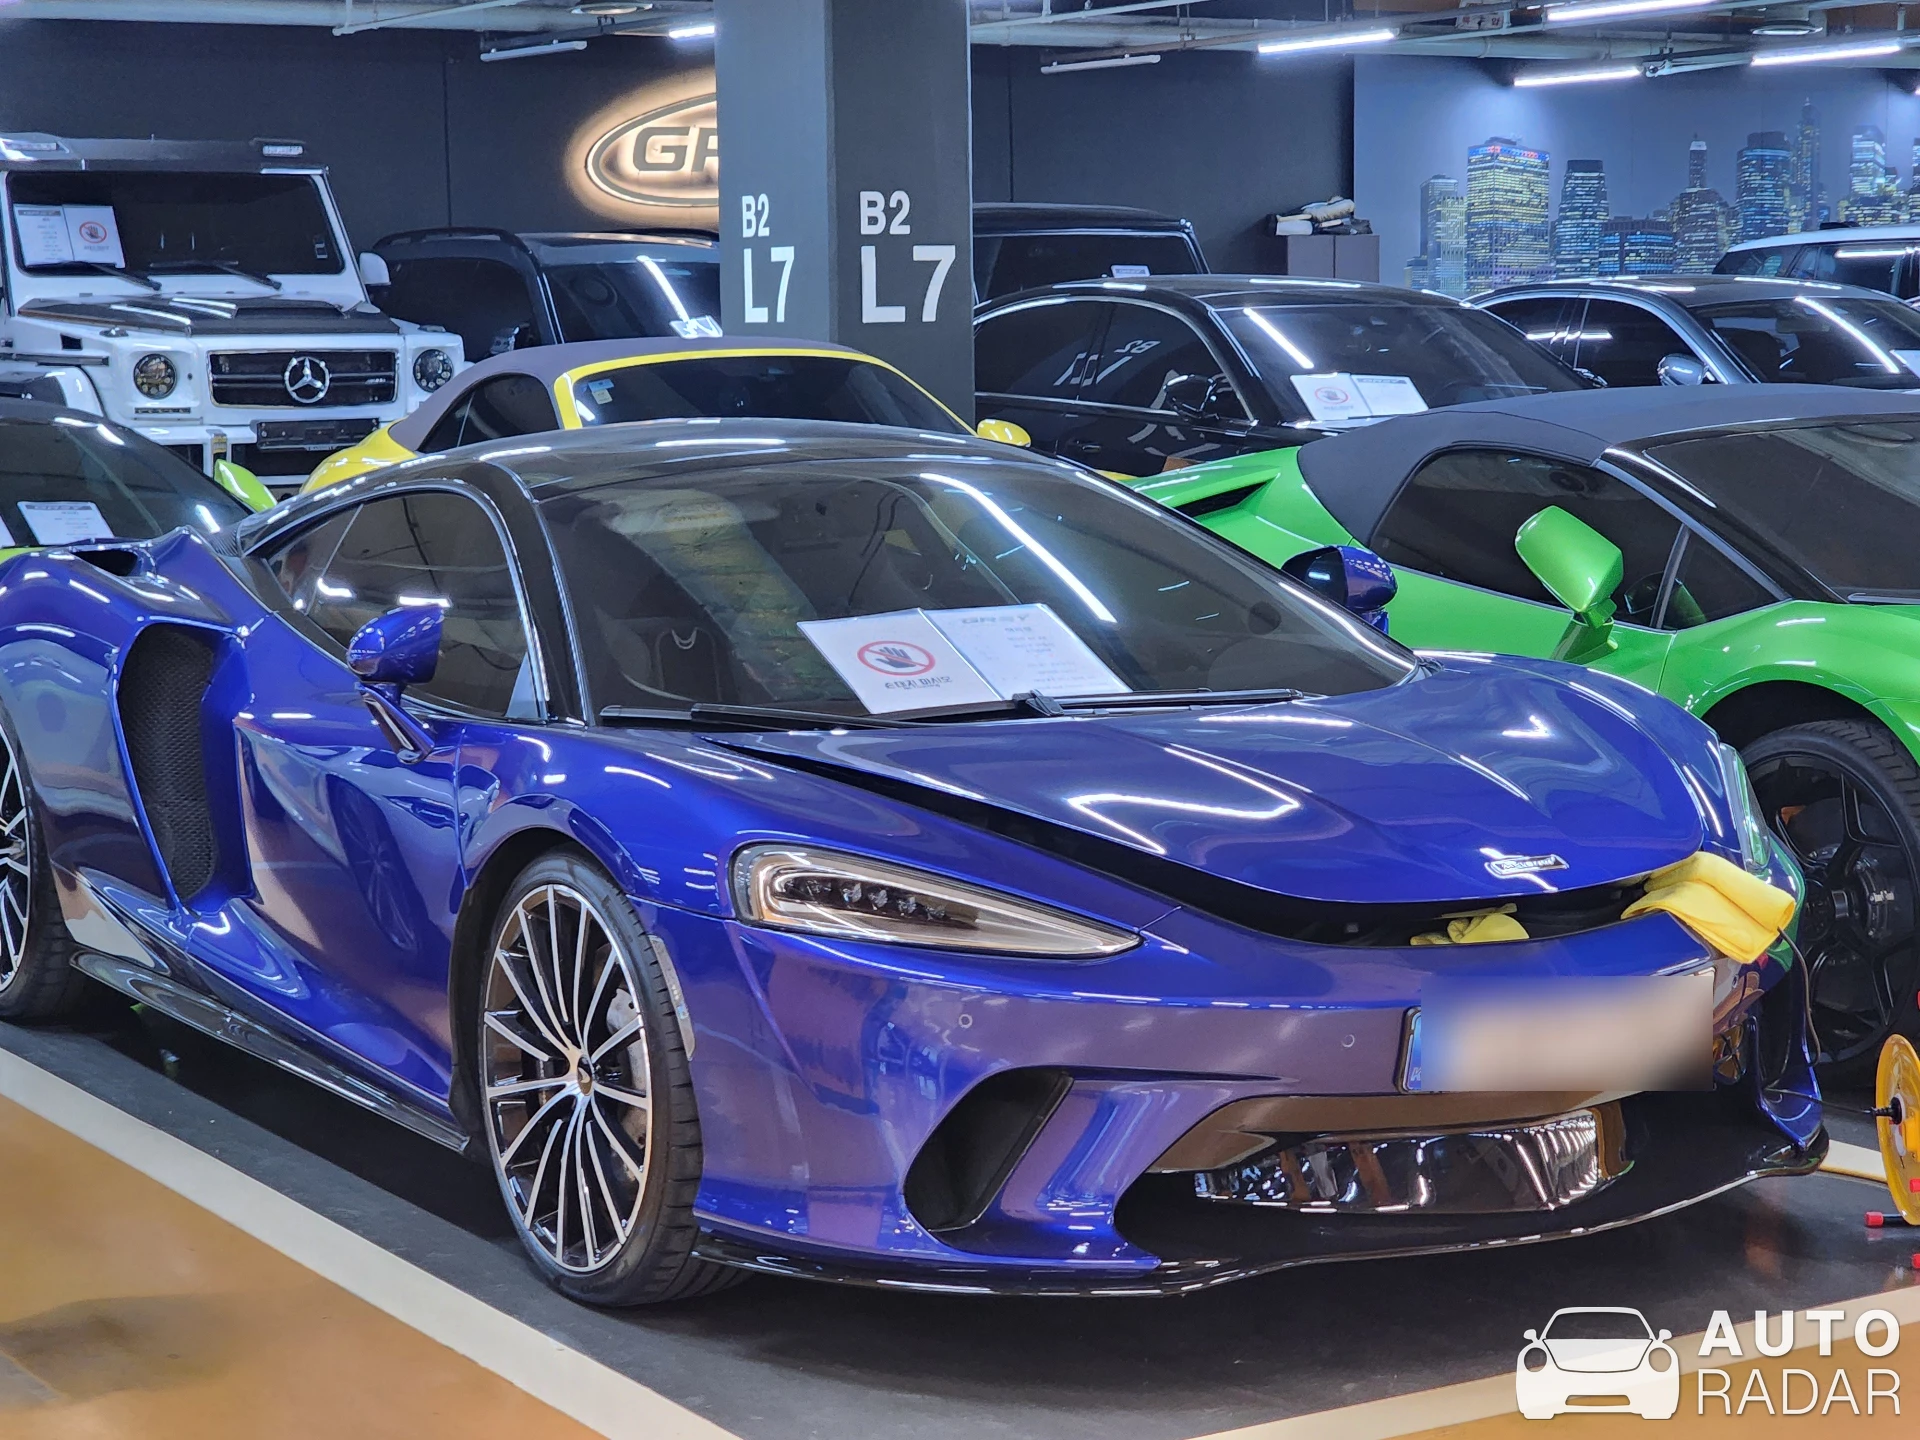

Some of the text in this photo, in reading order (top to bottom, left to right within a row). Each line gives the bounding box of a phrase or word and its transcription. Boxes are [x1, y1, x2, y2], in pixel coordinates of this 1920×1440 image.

[742, 193, 770, 238] B2
[860, 190, 911, 235] B2
[743, 246, 795, 323] L7
[861, 245, 956, 323] L7
